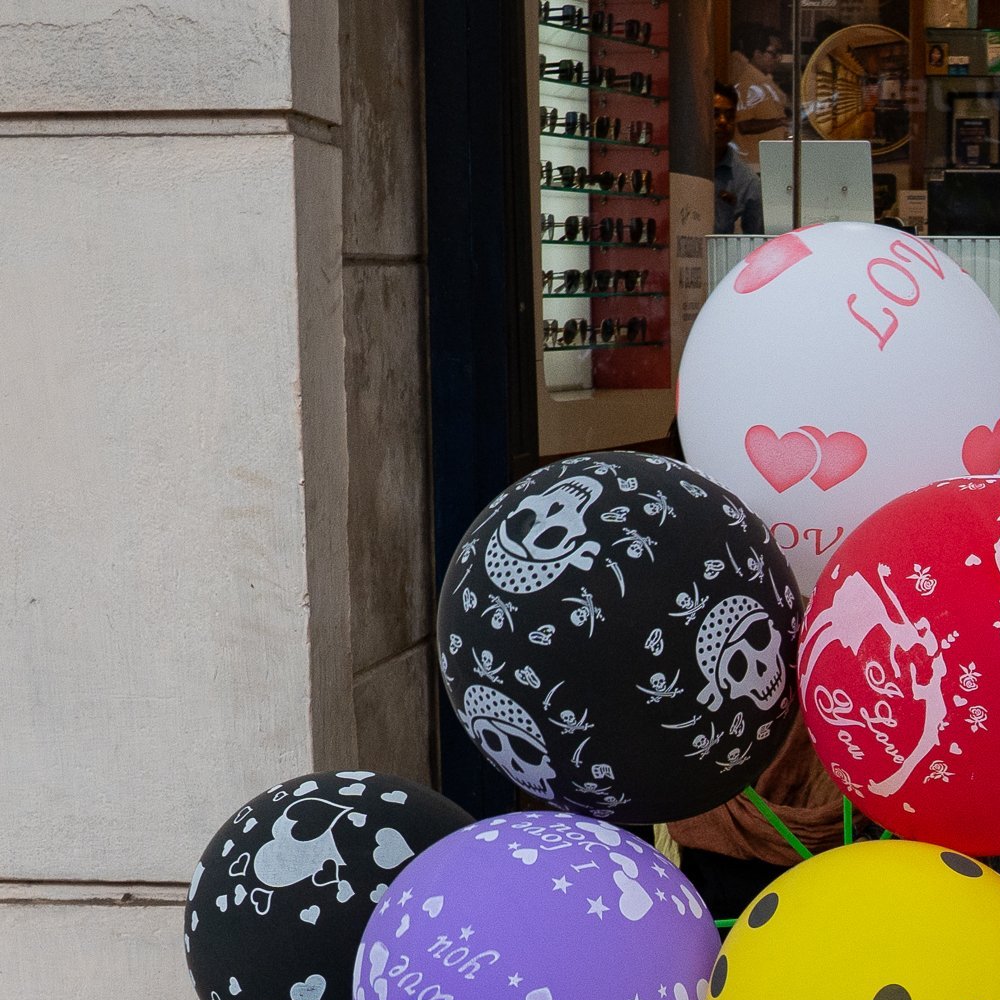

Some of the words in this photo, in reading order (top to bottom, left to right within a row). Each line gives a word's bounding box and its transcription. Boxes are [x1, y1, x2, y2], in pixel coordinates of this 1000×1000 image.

[847, 231, 945, 351] LOV
[769, 521, 844, 556] OV
[865, 661, 904, 698] I
[814, 685, 866, 760] You
[860, 700, 905, 764] Love
[511, 821, 573, 851] love
[549, 823, 611, 853] you
[570, 860, 600, 873] I
[427, 936, 501, 979] you
